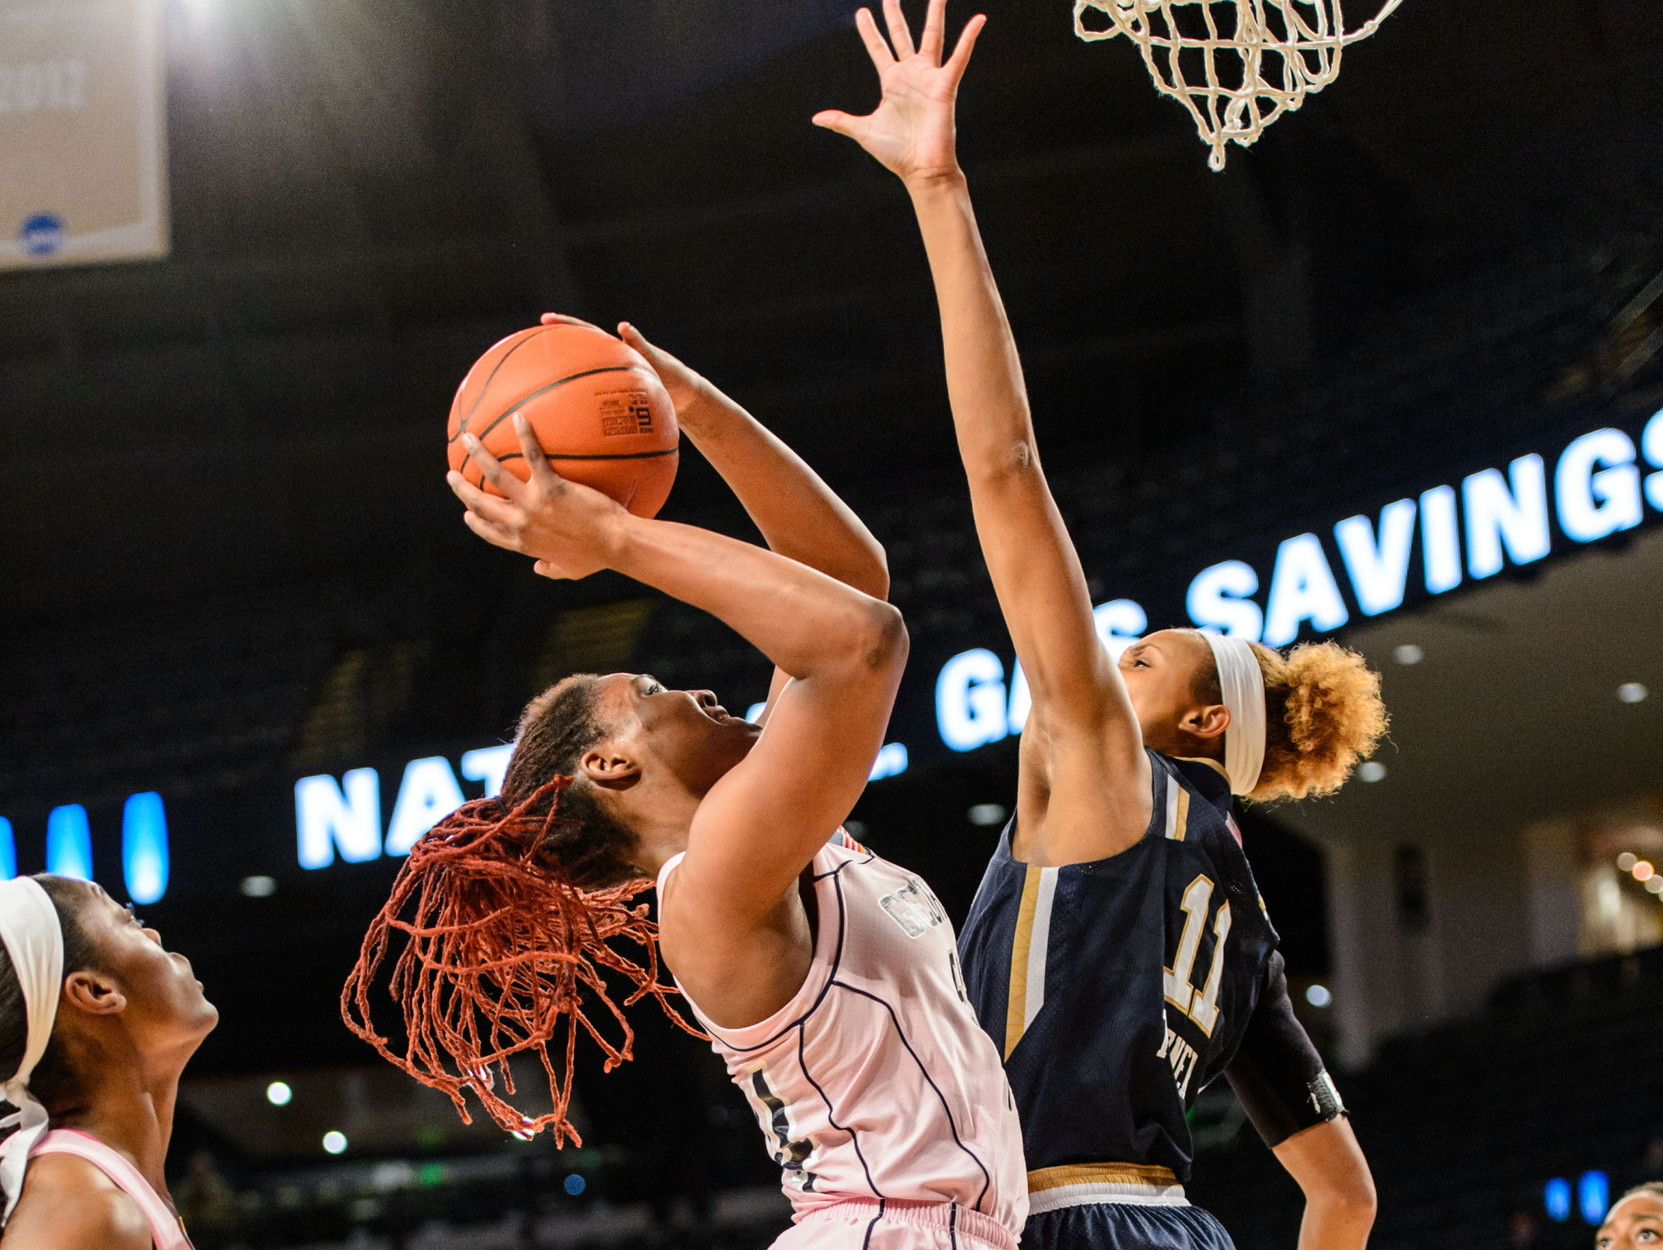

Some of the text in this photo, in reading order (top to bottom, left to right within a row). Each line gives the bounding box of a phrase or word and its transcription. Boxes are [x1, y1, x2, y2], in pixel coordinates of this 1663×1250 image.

[935, 598, 1147, 752] GS
[1186, 408, 1663, 649] SAVING
[1163, 874, 1232, 1038] 11
